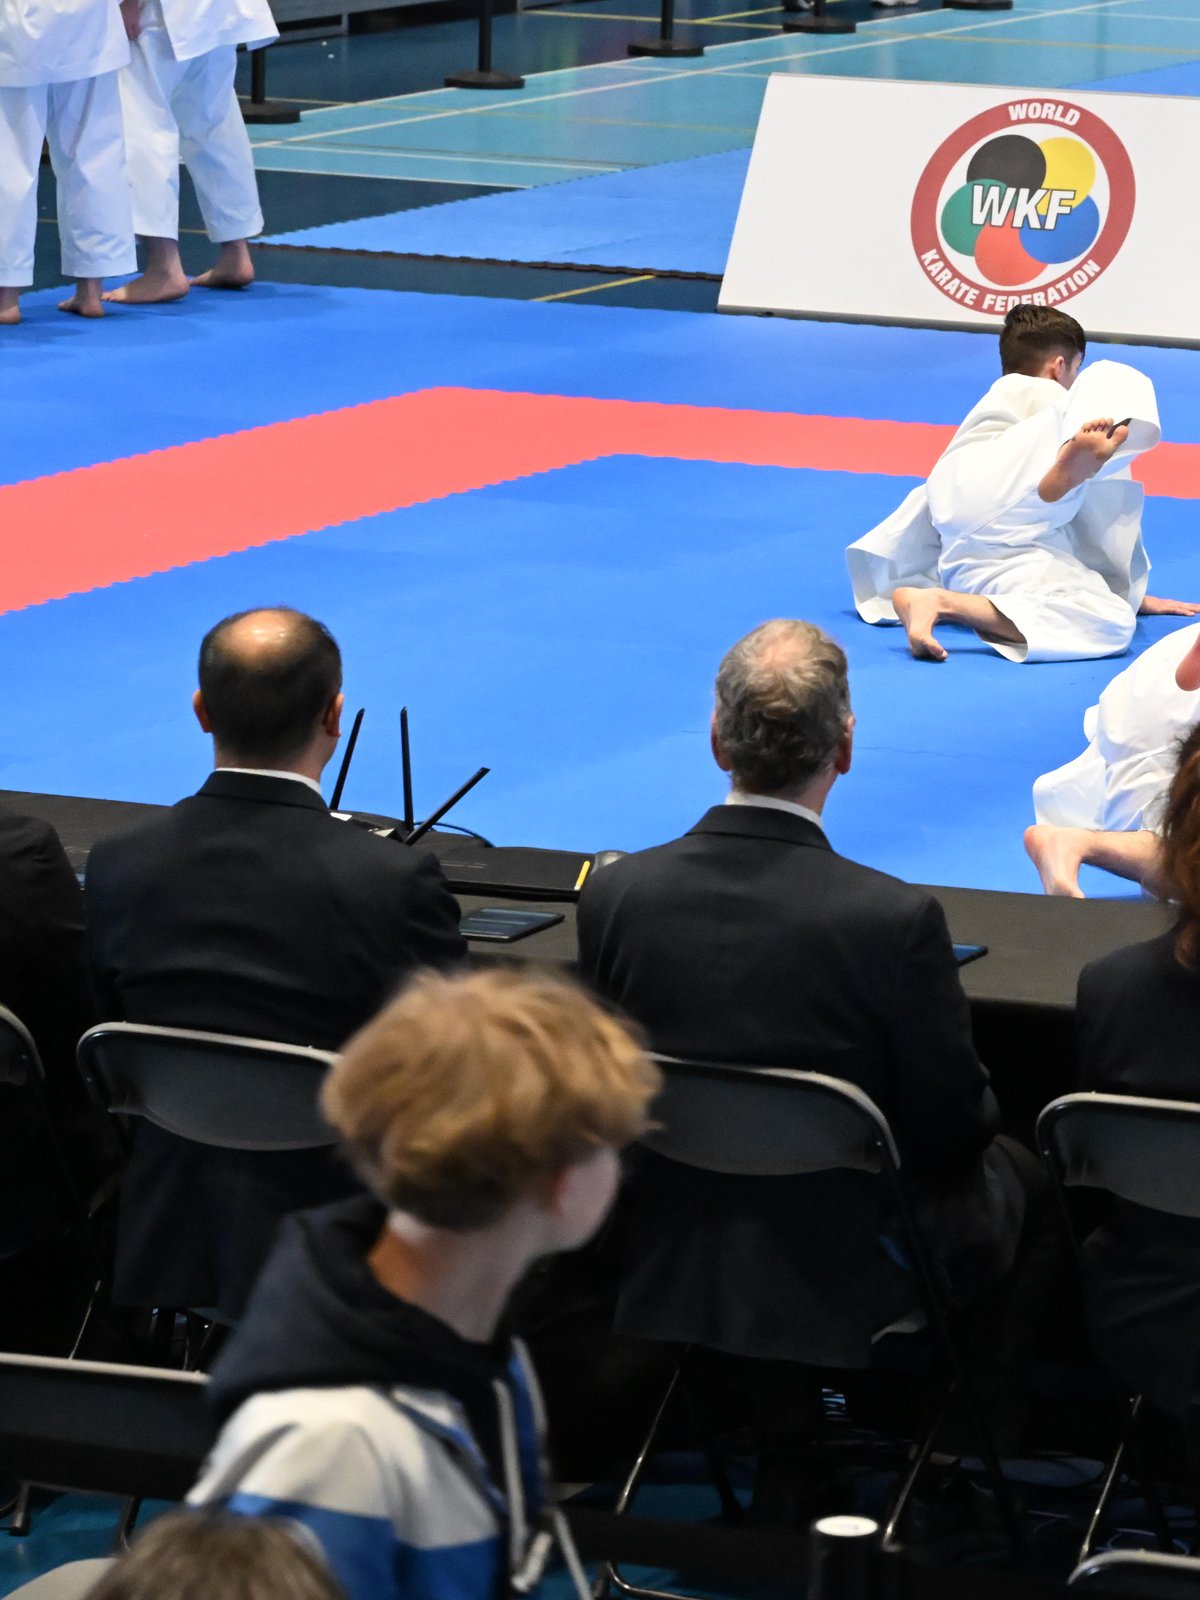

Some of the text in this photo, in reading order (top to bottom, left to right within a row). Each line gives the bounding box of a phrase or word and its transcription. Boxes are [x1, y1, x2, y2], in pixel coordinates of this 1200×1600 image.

[1008, 102, 1081, 126] WORLD
[970, 184, 1077, 231] WKF
[921, 248, 980, 306] KARATE
